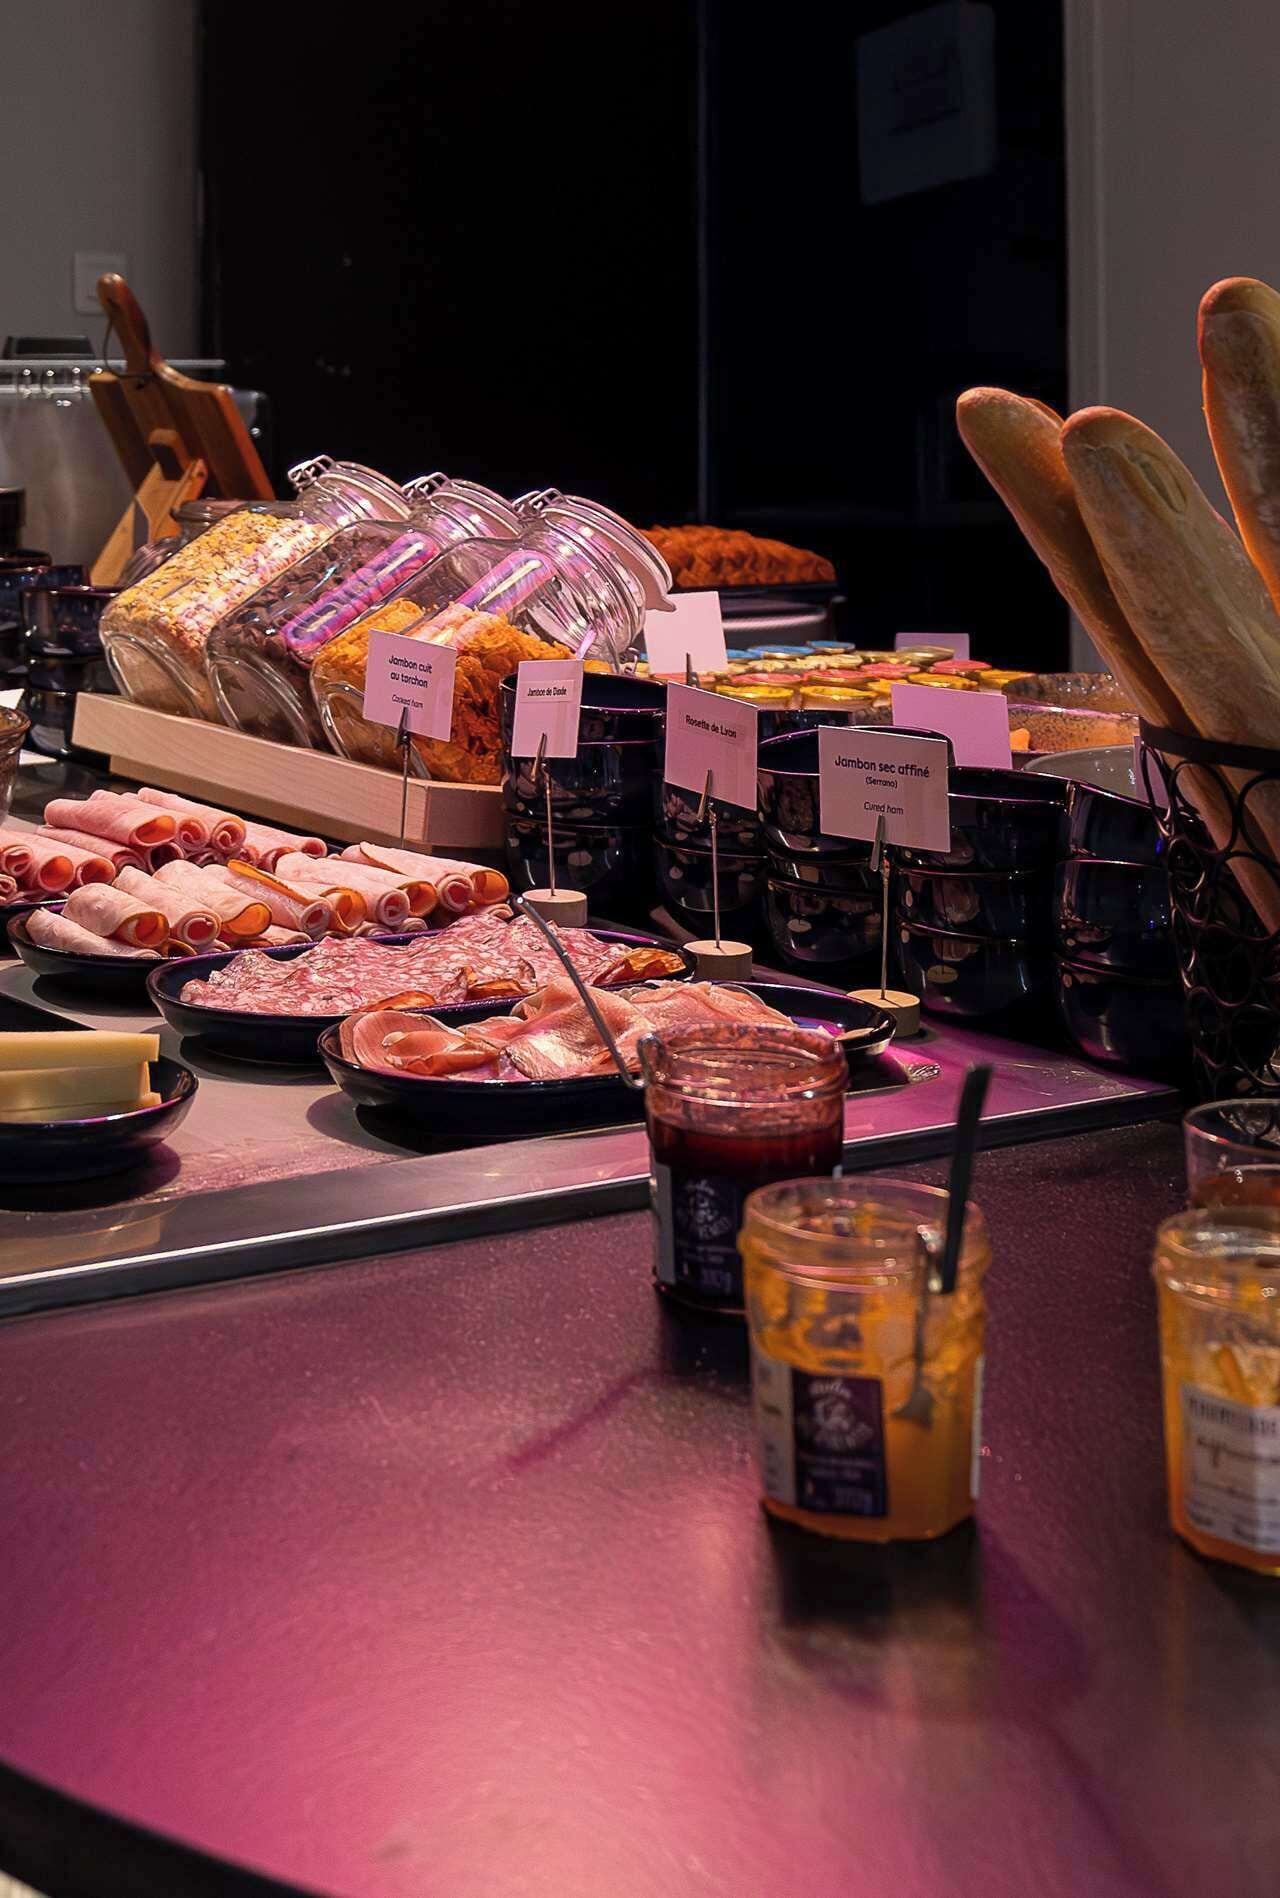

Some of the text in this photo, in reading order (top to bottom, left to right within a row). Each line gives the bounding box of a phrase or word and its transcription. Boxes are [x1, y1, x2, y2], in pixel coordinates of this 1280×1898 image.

[388, 655, 433, 674] Jambon cuit
[390, 672, 428, 688] au torchon
[546, 687, 553, 696] de
[391, 694, 424, 709] Cooked ham
[685, 714, 737, 738] Rosette de Lyon
[835, 755, 931, 778] Jambon sec affiné
[865, 776, 898, 789] (Serrano)
[863, 801, 904, 815] Cured ham
